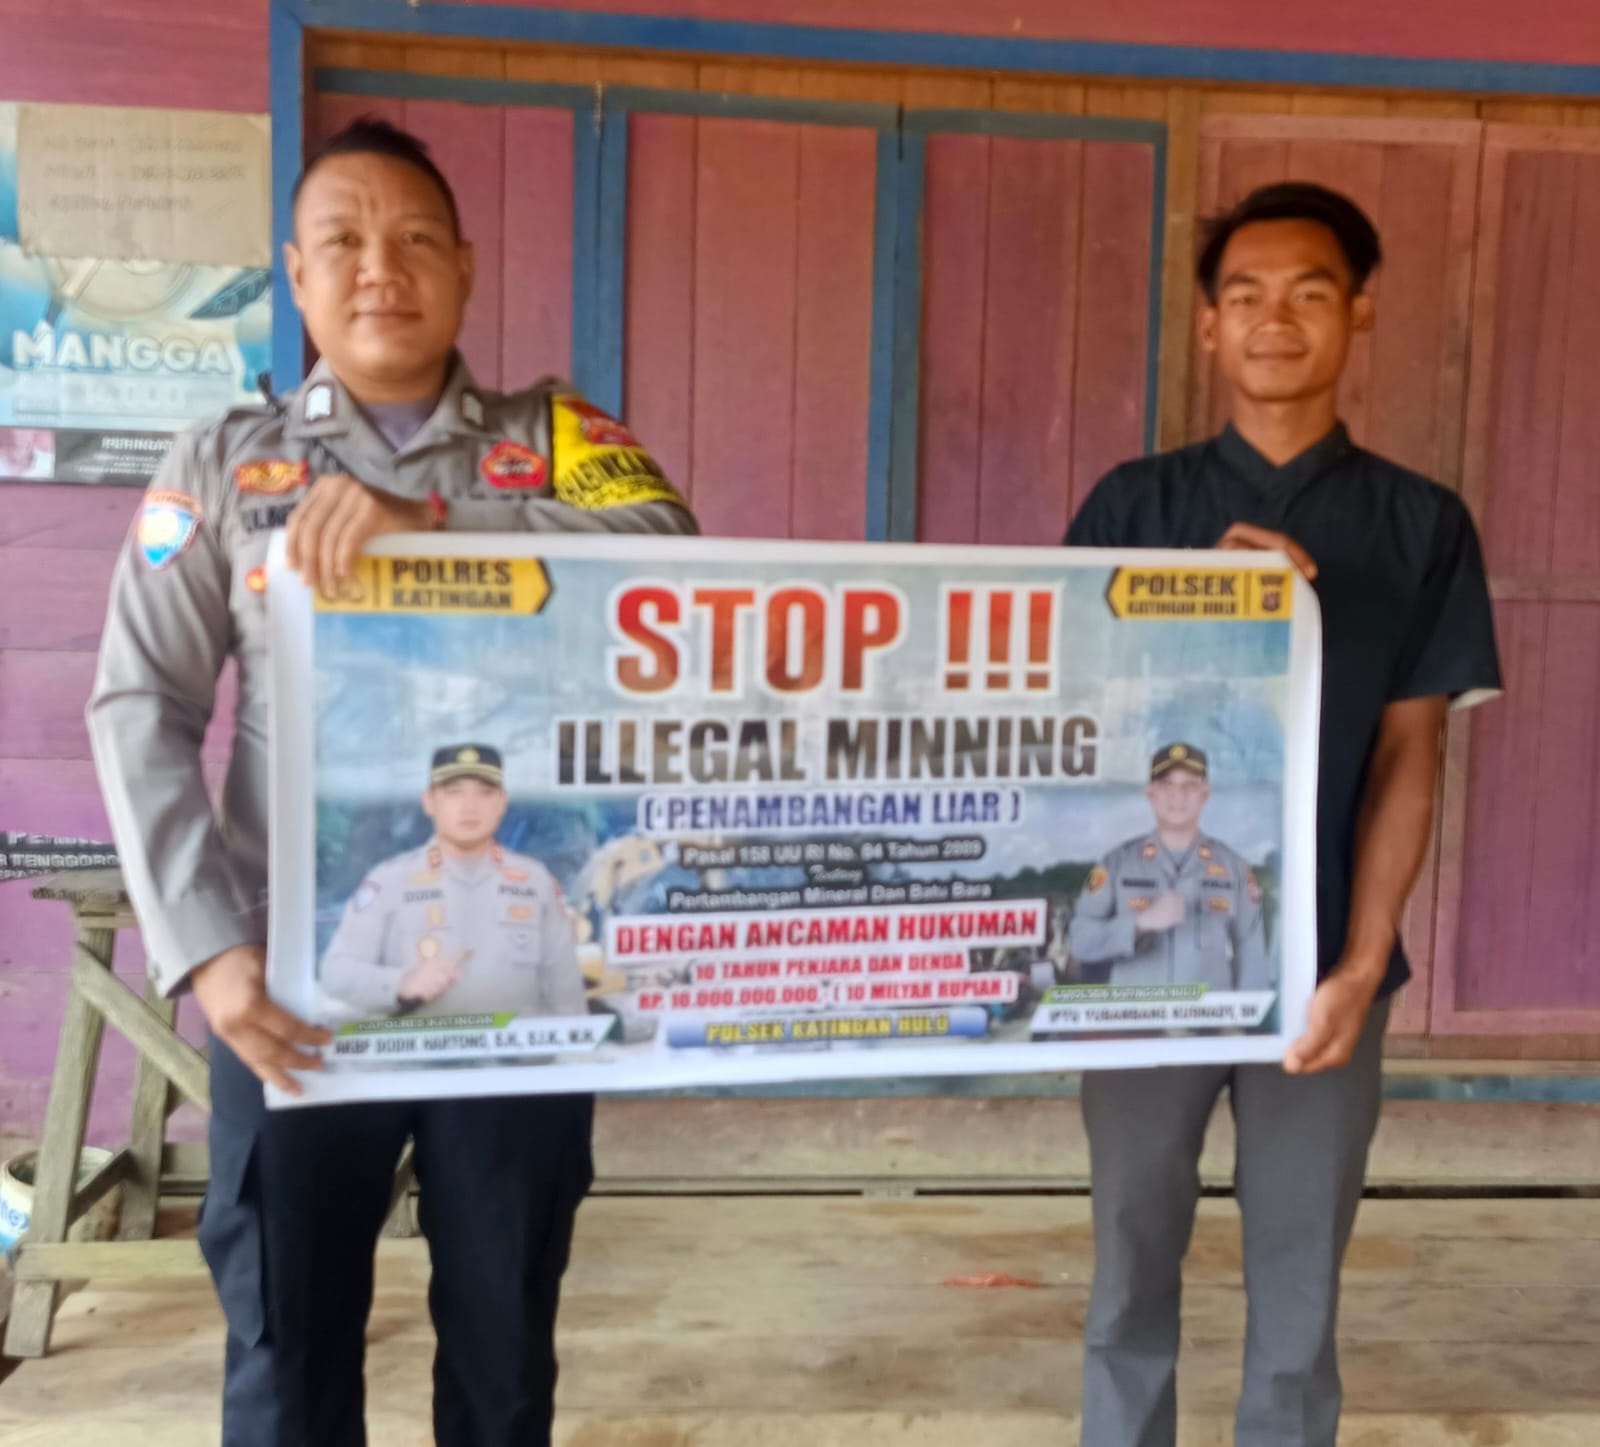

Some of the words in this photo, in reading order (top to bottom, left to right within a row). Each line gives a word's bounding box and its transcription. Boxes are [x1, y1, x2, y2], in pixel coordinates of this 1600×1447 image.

[12, 328, 232, 372] MANGGA
[391, 559, 511, 584] POLRES
[1129, 573, 1236, 597] POLSEK
[392, 588, 511, 608] KATINGAN
[613, 584, 904, 694] STOP
[943, 588, 1055, 692] !!!
[557, 716, 808, 786] ILLEGAL
[825, 714, 1099, 782] MINNING
[933, 791, 1001, 823] LIAR
[774, 845, 803, 863] UU
[887, 841, 939, 861] Tahun
[668, 889, 801, 911] Pertambangan
[803, 886, 869, 906] Mineral
[870, 884, 907, 904] Dan
[908, 882, 950, 902] Batu
[951, 880, 993, 900] Bara
[616, 924, 737, 955] DENGAN
[745, 914, 890, 948] ANCAMAN
[898, 909, 1037, 941] HUKUMAN
[696, 964, 715, 981] 10
[721, 961, 780, 980] TAHUN
[787, 955, 862, 977] PENJARA
[868, 955, 902, 974] DAN
[908, 953, 963, 972] DENDA
[847, 984, 864, 1000] 10
[870, 980, 932, 1000] MILYAR
[938, 978, 1000, 998] RUPIAH
[707, 1021, 784, 1040] POLSEK
[793, 1016, 892, 1037] KATINGAN
[898, 1014, 949, 1034] HULU
